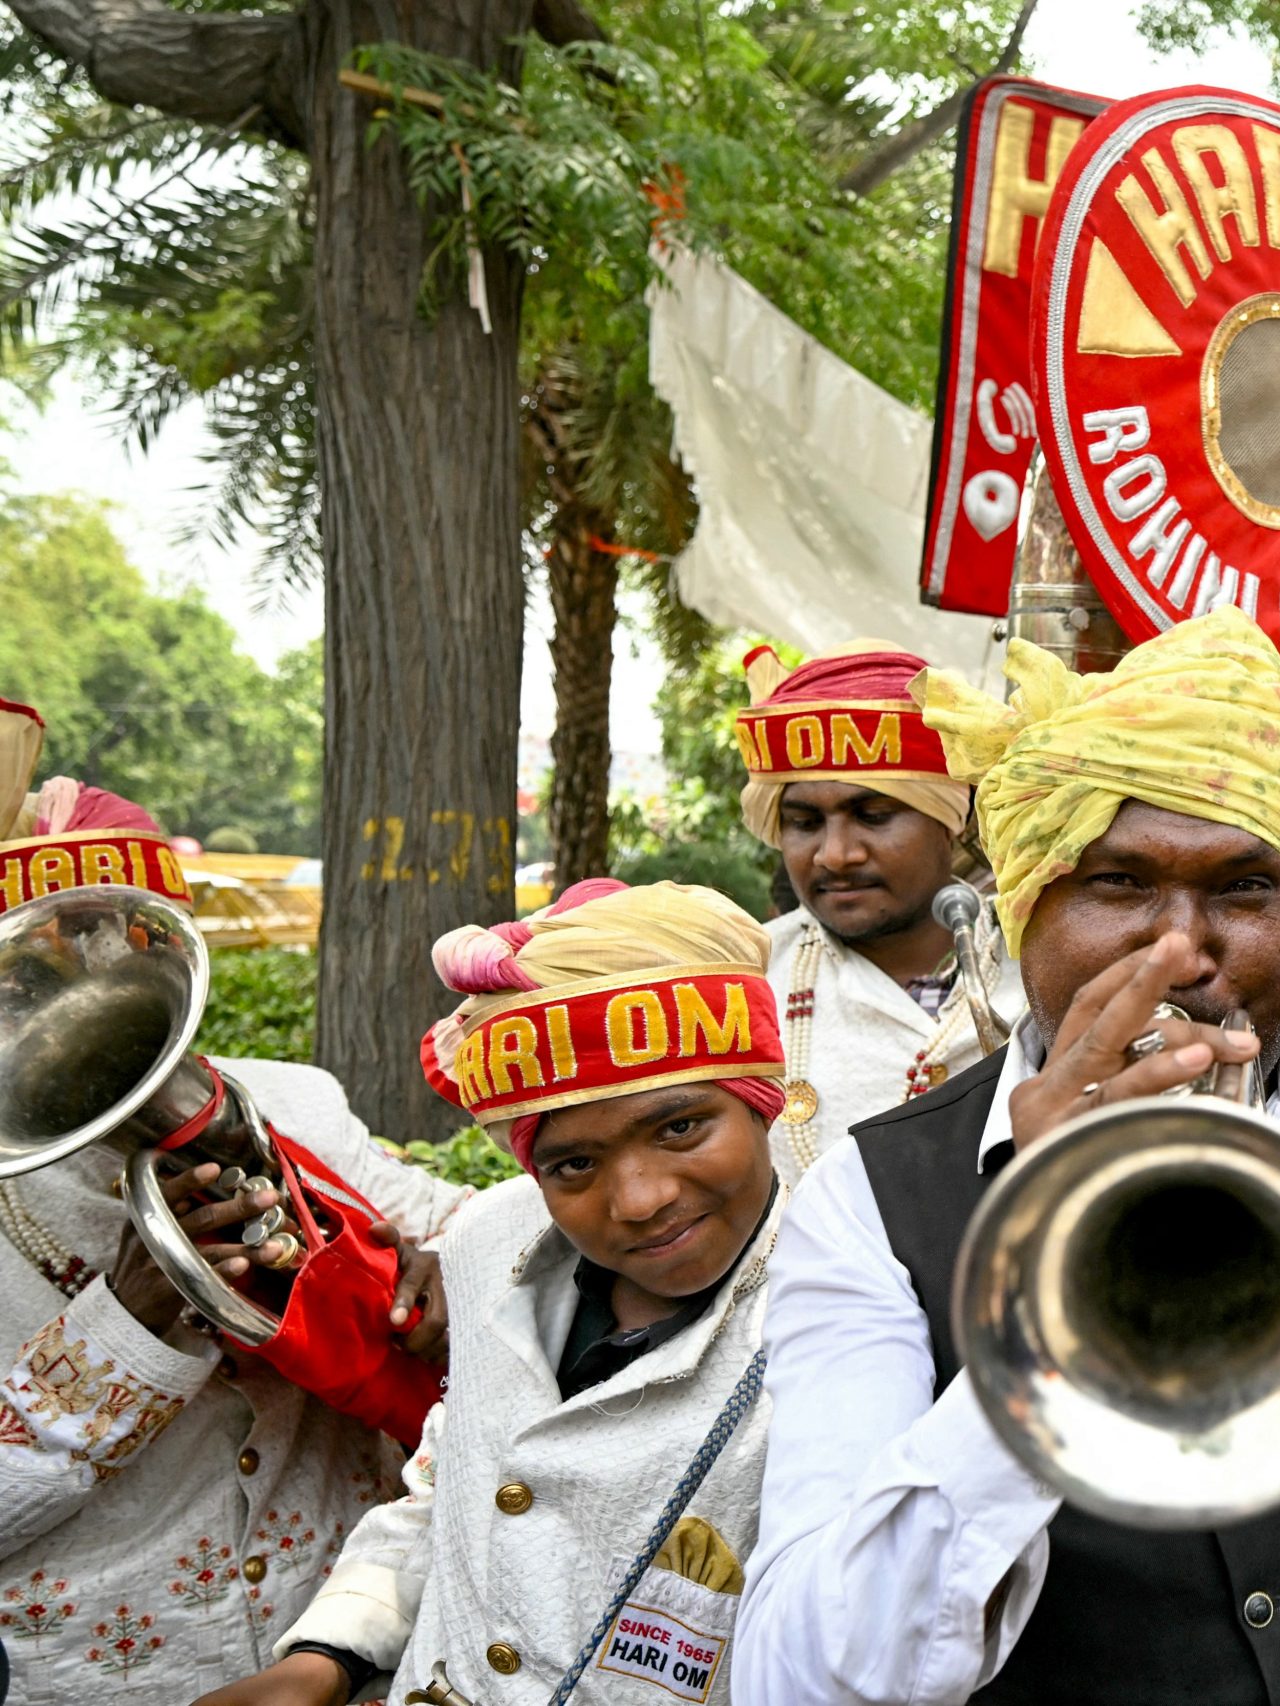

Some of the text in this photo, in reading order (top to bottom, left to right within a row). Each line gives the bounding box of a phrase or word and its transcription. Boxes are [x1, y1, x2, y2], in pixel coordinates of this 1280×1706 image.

[1082, 405, 1260, 623] ROHINI
[785, 712, 902, 769] OM
[605, 982, 752, 1068] OM
[610, 1637, 710, 1690] HARI OM
[618, 1619, 716, 1664] SINCE 1965
